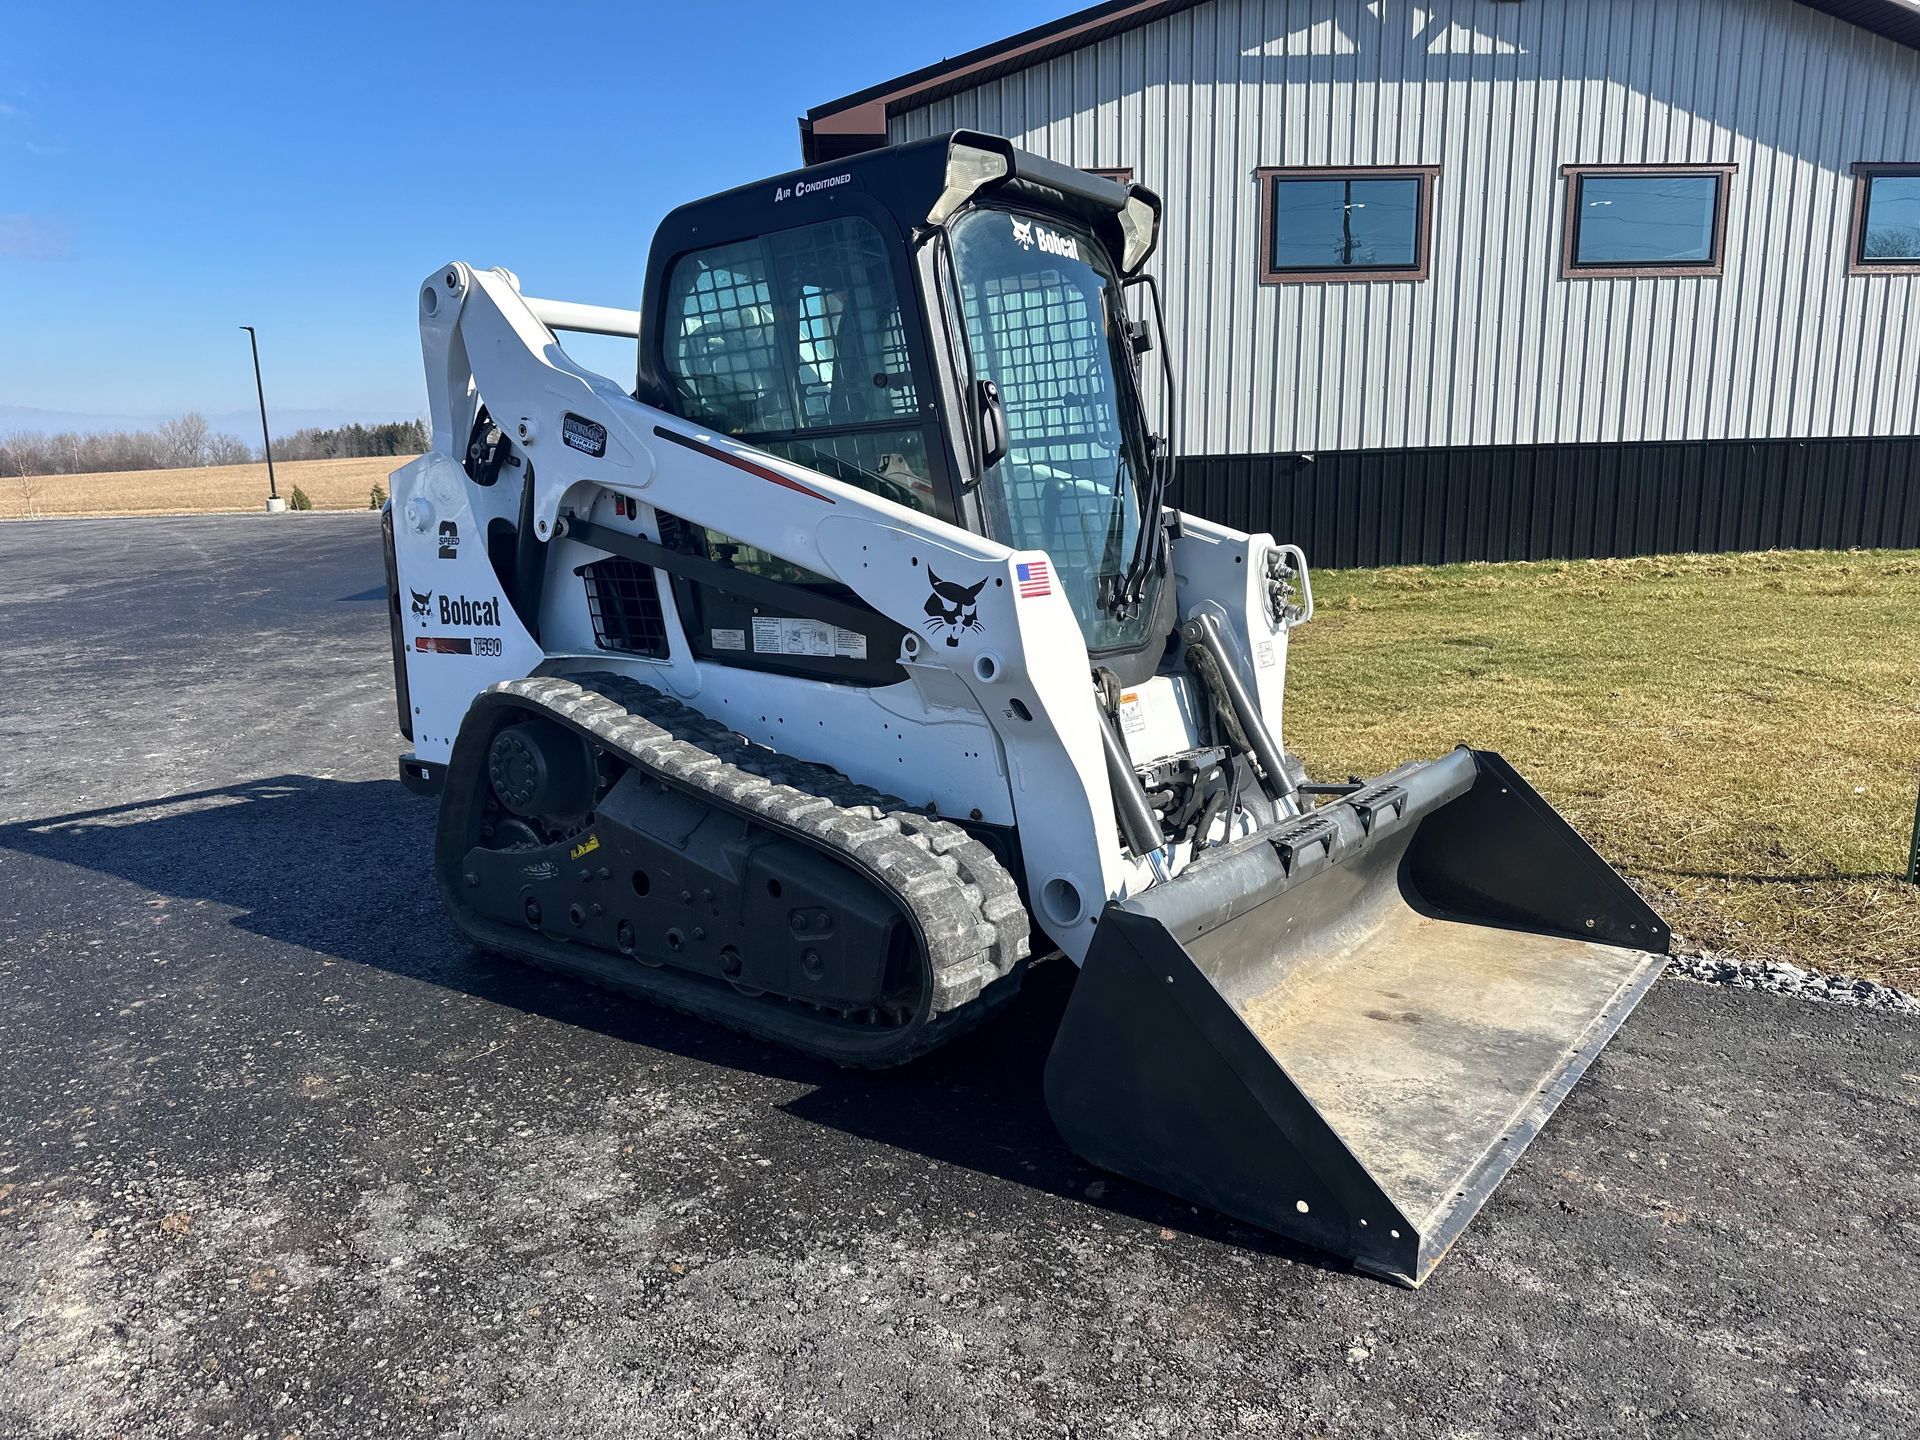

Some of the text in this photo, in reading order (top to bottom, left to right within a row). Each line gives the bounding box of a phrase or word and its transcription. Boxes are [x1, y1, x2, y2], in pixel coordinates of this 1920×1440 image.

[774, 173, 851, 202] AIR CONDITIONED
[1035, 226, 1080, 261] Bobcat
[438, 520, 458, 559] 2
[438, 537, 460, 545] SPEED
[438, 595, 501, 626] Bobcat
[473, 637, 502, 656] T590
